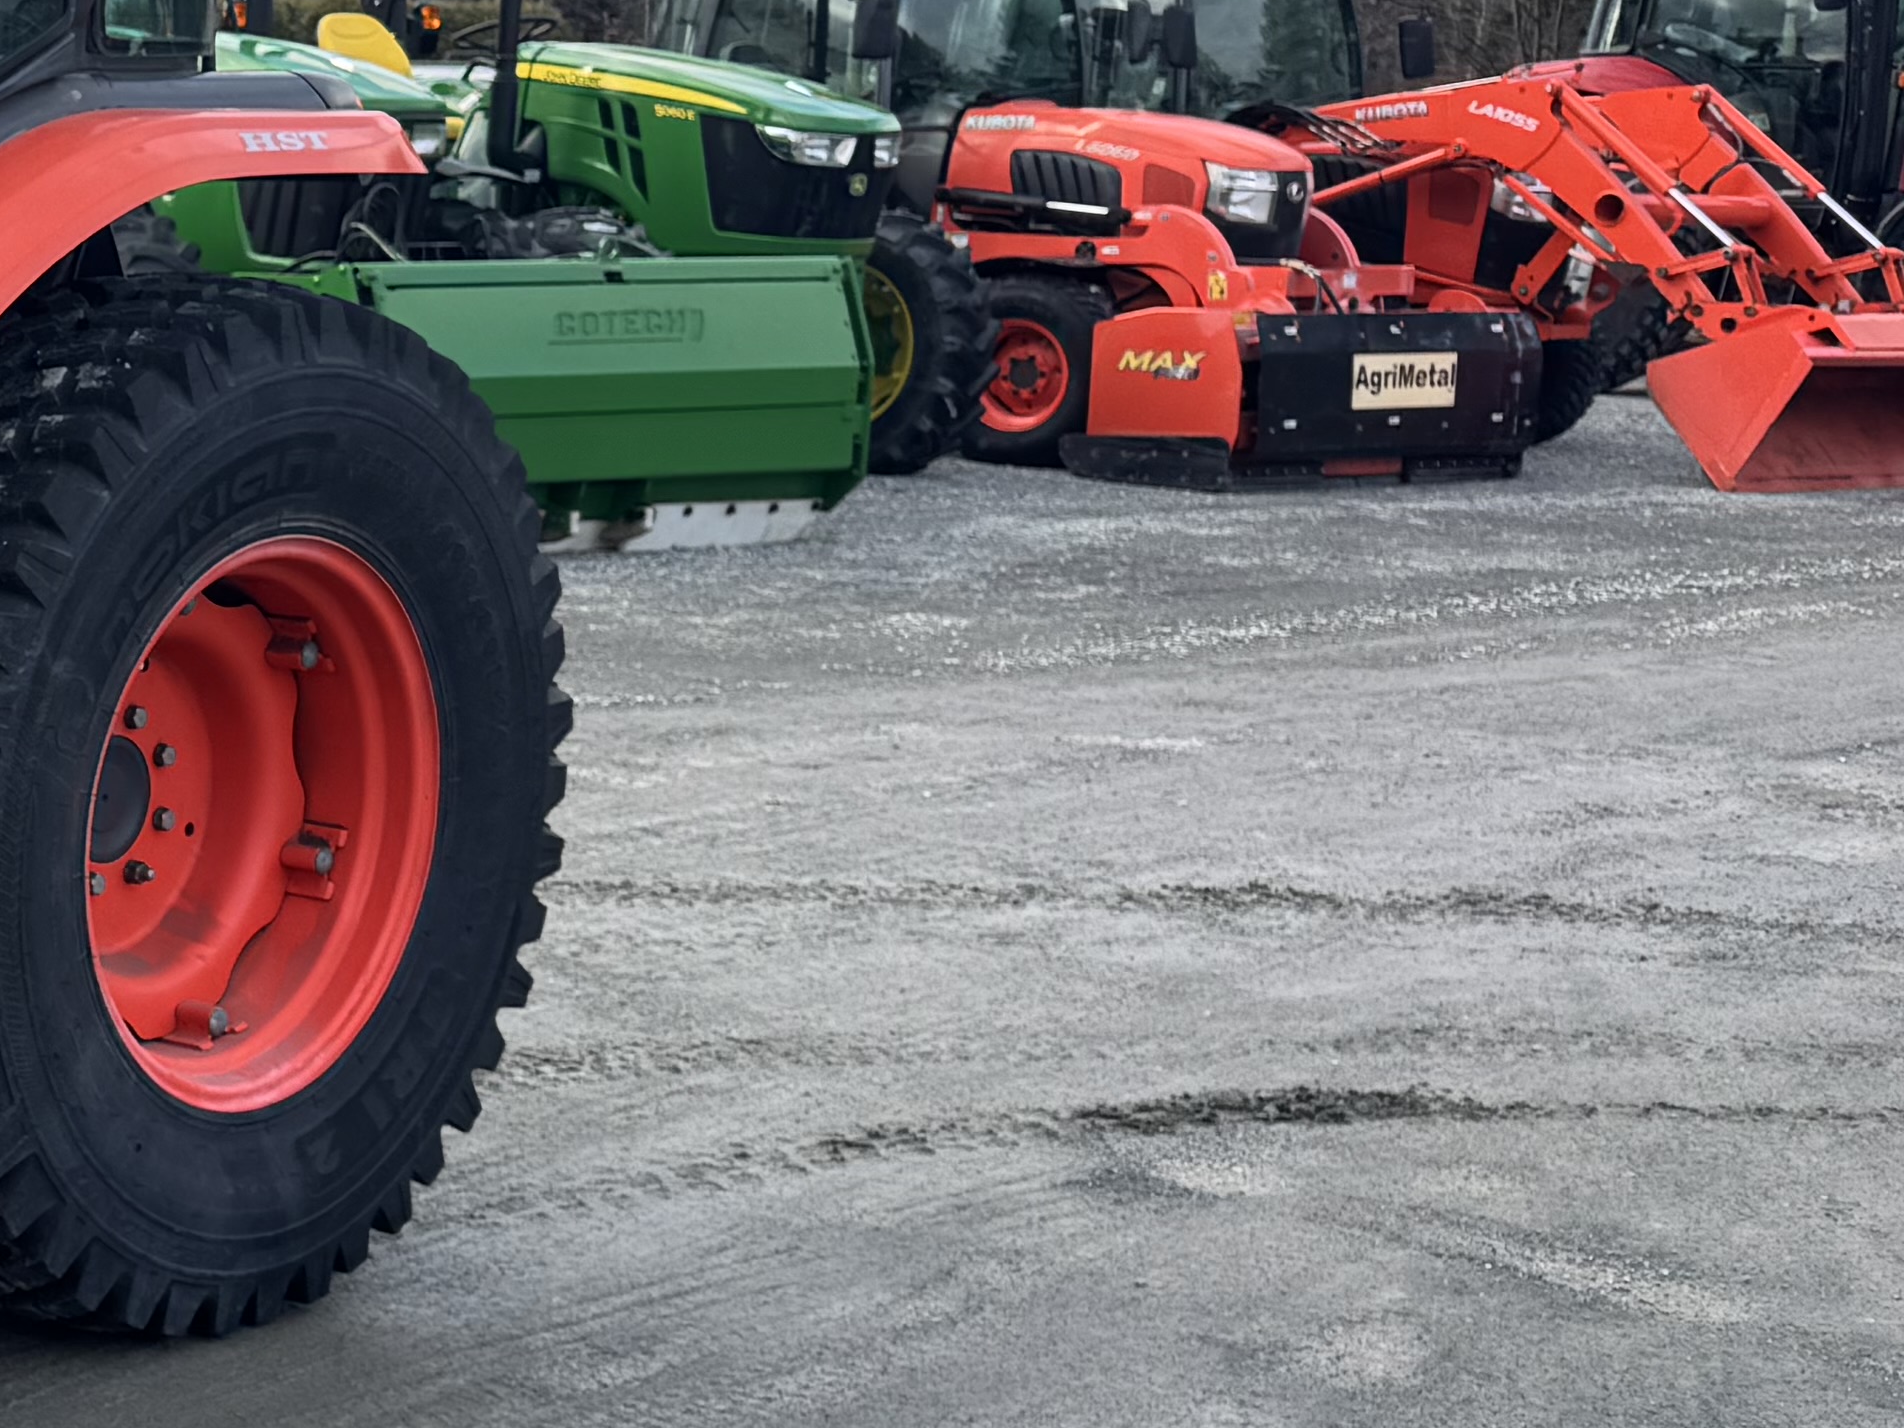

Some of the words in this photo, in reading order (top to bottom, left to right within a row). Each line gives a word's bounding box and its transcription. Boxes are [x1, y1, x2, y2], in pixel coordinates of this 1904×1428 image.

[1355, 100, 1429, 122] KUBOTA
[965, 114, 1036, 131] KUBOTA
[238, 131, 329, 153] HST
[1117, 348, 1208, 372] MAX
[1355, 362, 1456, 395] AgriMetal
